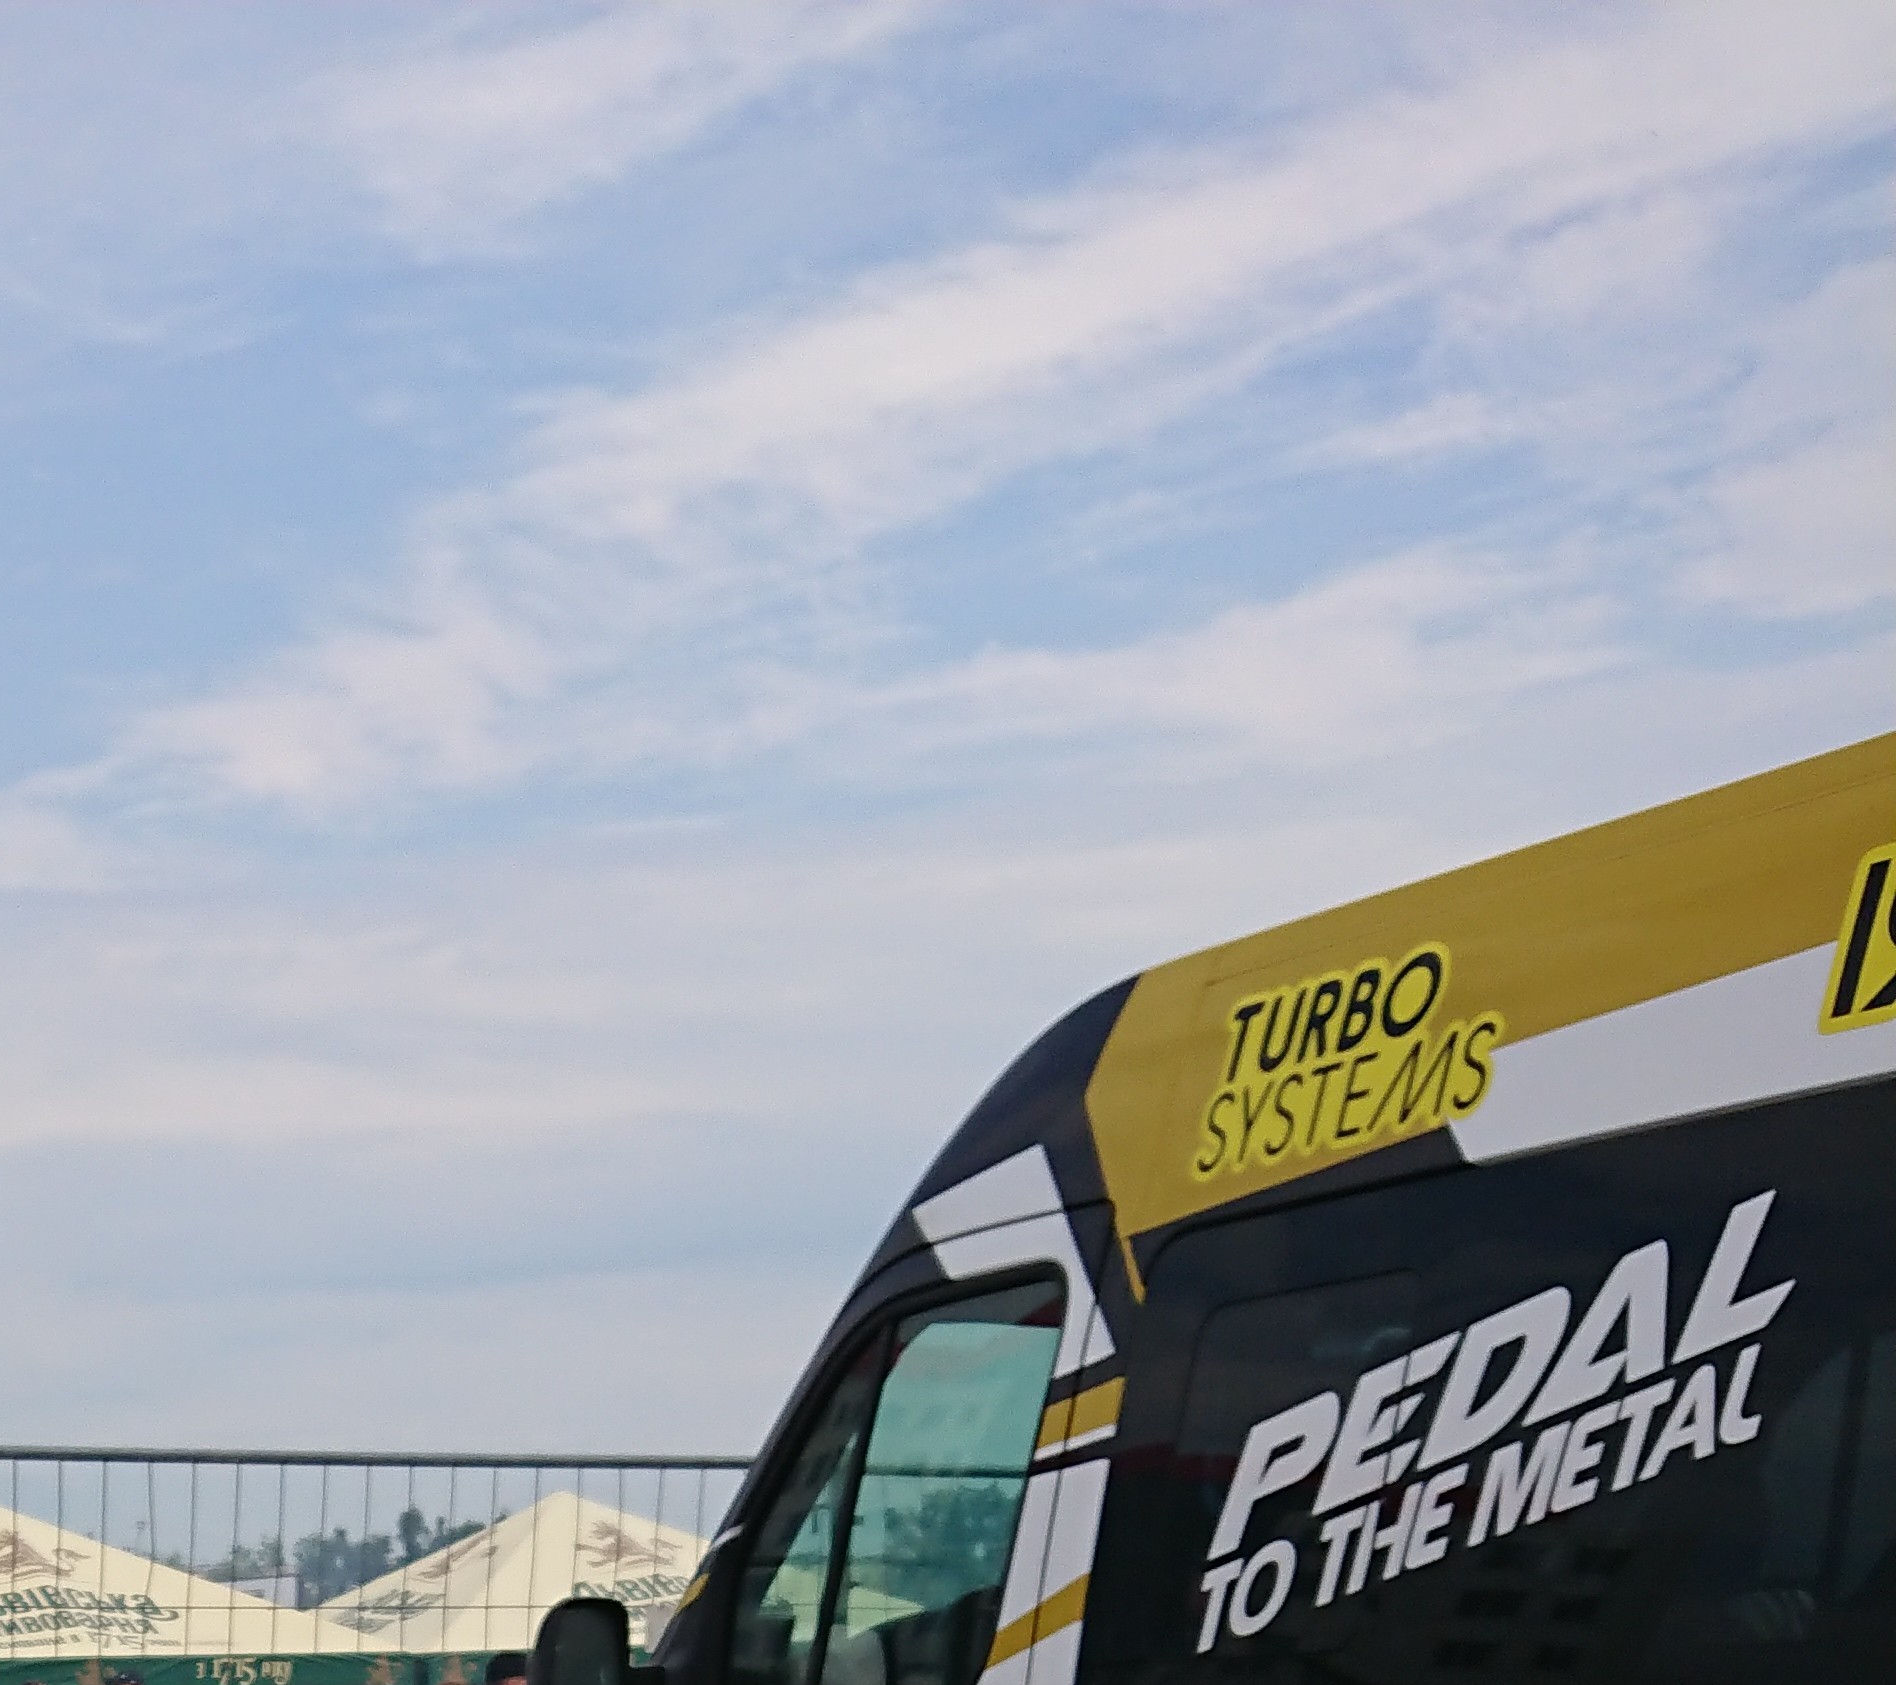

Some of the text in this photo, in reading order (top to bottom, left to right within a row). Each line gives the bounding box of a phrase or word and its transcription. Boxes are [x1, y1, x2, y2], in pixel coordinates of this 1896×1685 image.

[1196, 1022, 1500, 1173] SYSTEMS
[1225, 951, 1443, 1085] TURBO
[1205, 1188, 1796, 1561] PEDAL
[1196, 1343, 1763, 1654] TO THE METAL
